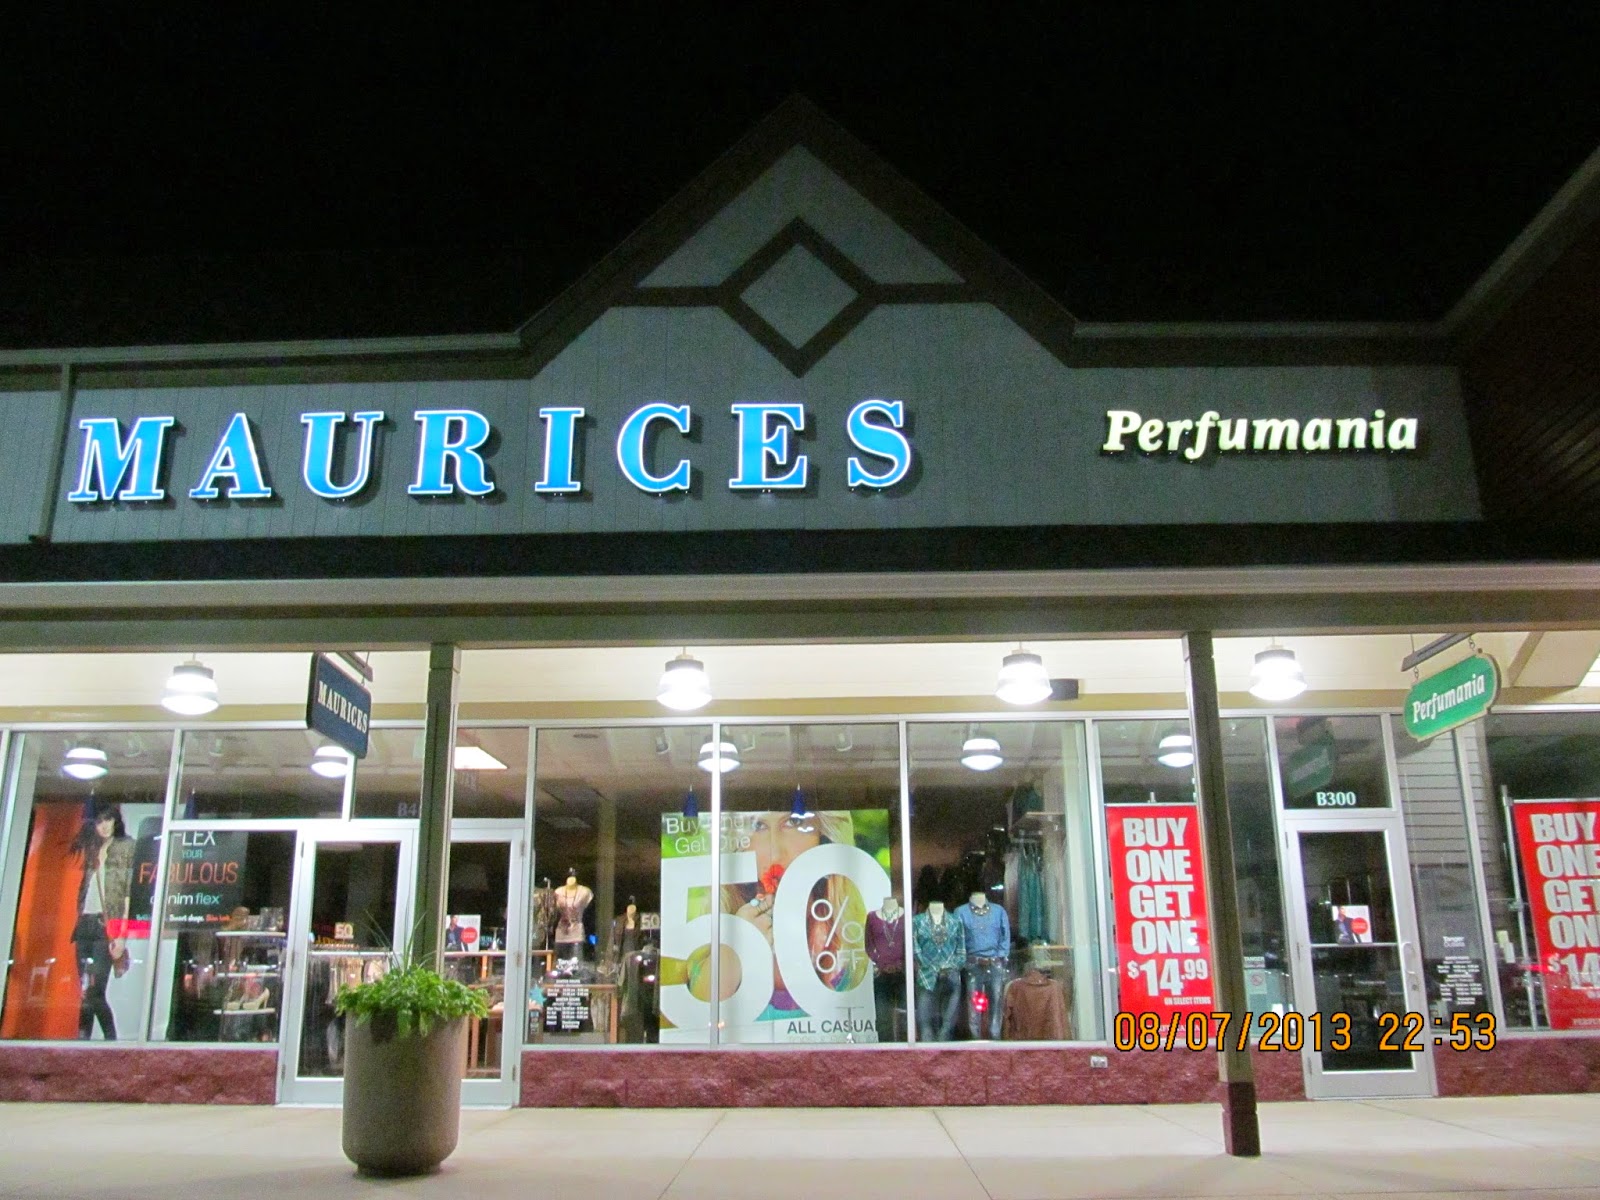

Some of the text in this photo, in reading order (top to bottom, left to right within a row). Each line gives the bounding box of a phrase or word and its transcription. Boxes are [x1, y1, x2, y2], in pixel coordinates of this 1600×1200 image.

[67, 399, 912, 502] MAURICES
[1102, 408, 1418, 460] Perfumania
[317, 680, 369, 734] MAURICES
[1412, 673, 1486, 724] Perfumania
[1316, 791, 1357, 807] B300
[666, 816, 700, 836] Buy
[1123, 818, 1188, 847] BUY
[1530, 811, 1597, 843] BUY
[675, 836, 706, 854] Get
[1536, 843, 1600, 878] ONE
[1125, 848, 1194, 883] ONE
[1129, 883, 1195, 919] GET
[660, 842, 893, 1028] 50
[1131, 919, 1200, 956] ONE
[1549, 913, 1600, 949] ON
[787, 1020, 817, 1034] ALL
